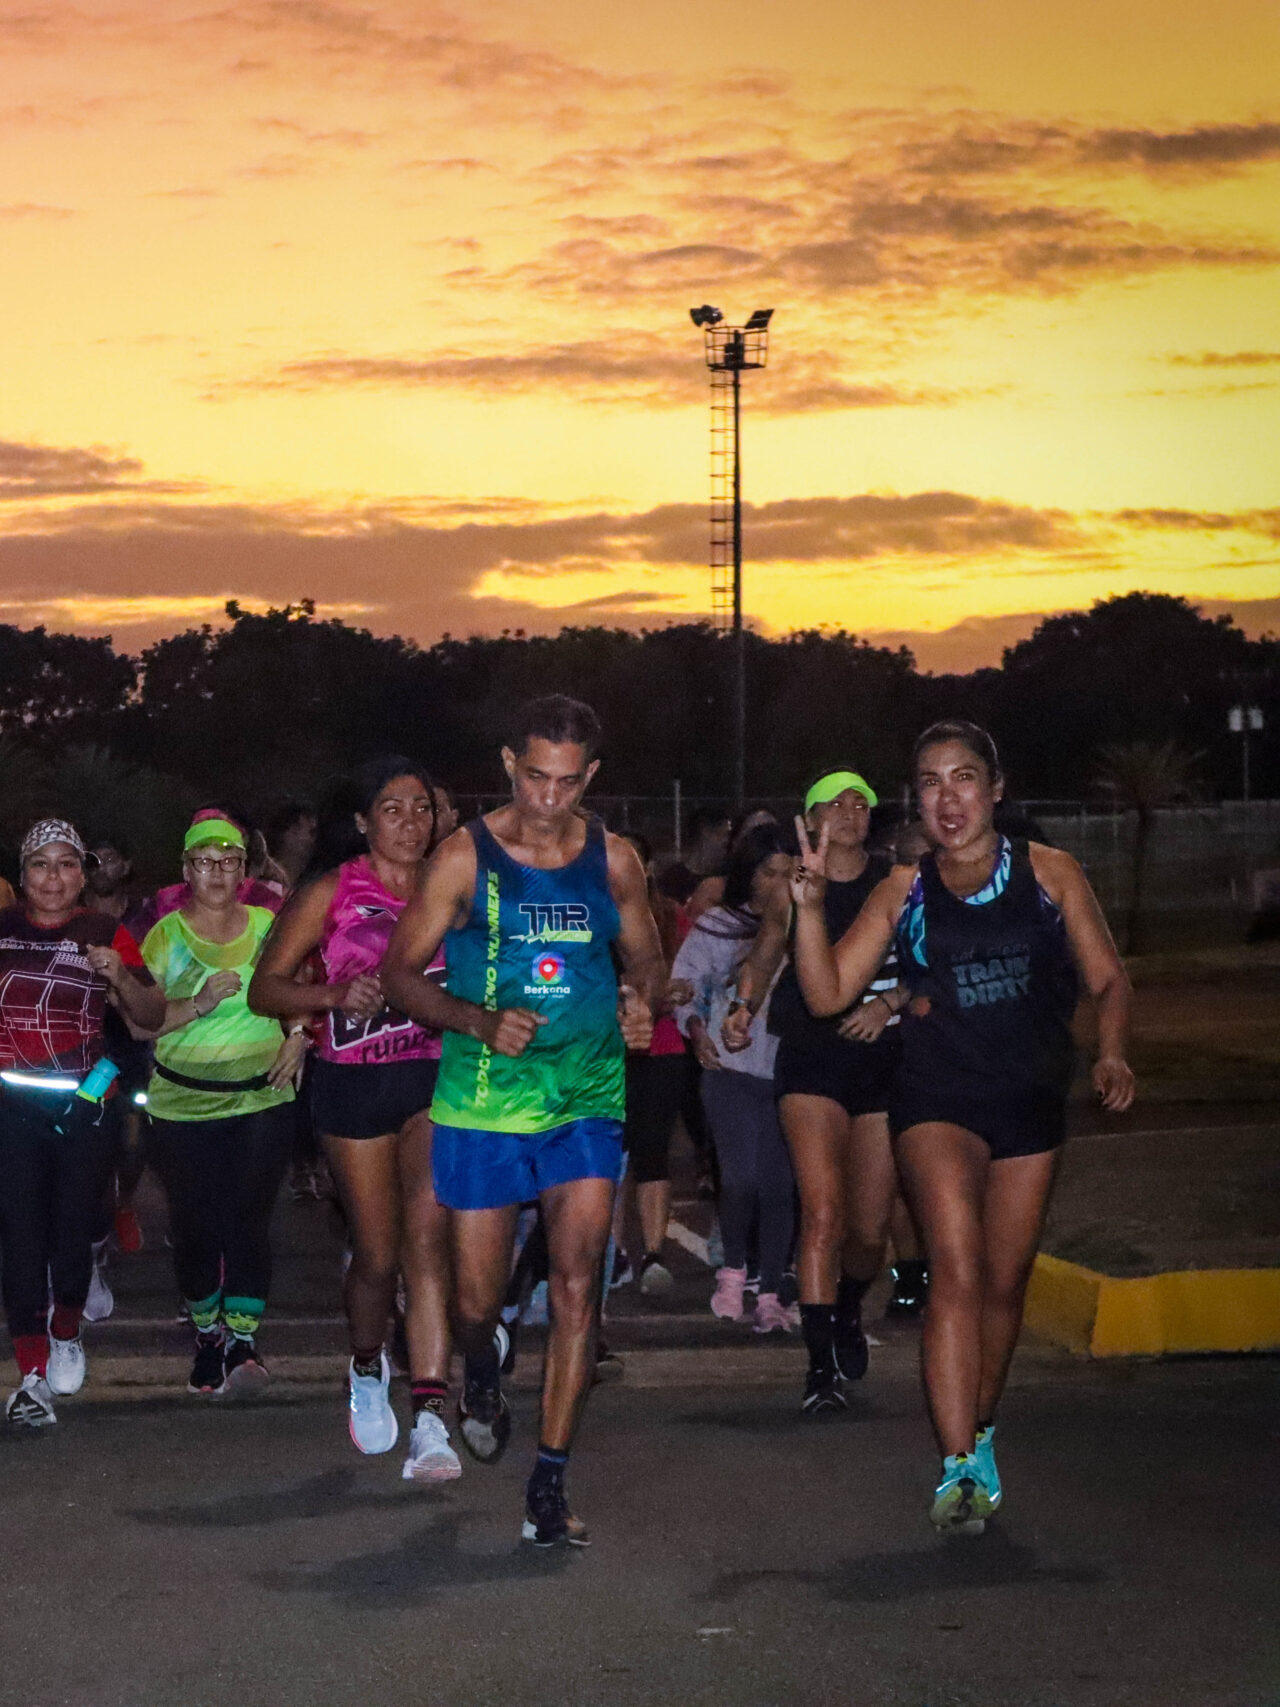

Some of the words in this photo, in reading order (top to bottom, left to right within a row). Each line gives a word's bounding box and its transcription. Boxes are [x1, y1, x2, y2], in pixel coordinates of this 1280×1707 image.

[31, 944, 79, 953] RUNNER
[524, 985, 570, 994] Berkana
[957, 975, 1030, 1008] DIRTY
